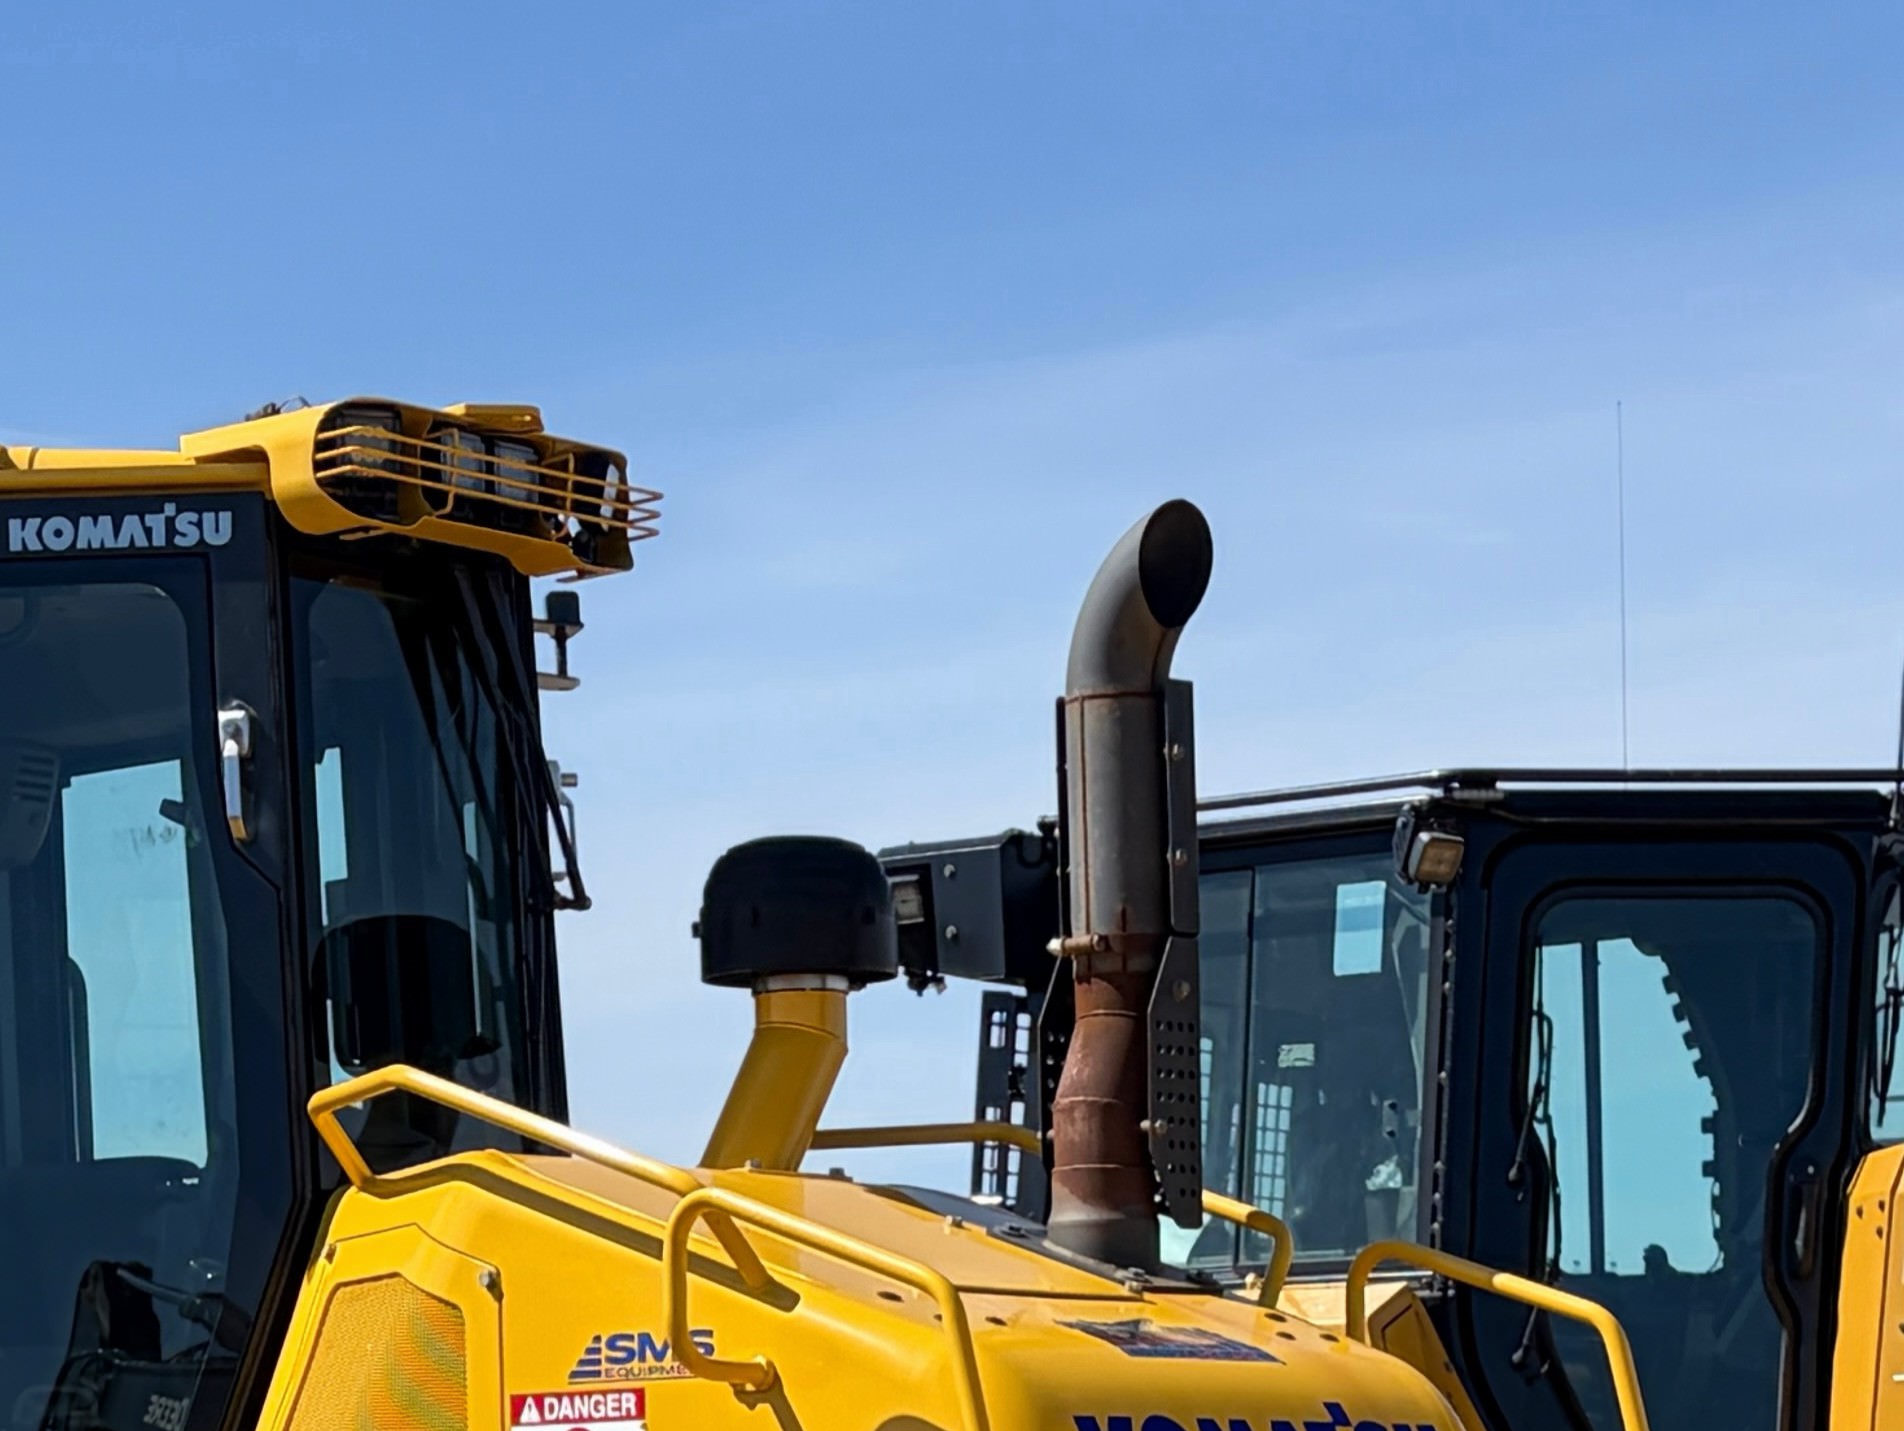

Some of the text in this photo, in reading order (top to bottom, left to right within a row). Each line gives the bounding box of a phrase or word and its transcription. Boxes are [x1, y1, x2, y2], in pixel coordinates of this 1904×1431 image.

[8, 502, 233, 552] KOMATSU
[605, 1364, 688, 1379] EQUIPME
[543, 1392, 637, 1421] DANGER
